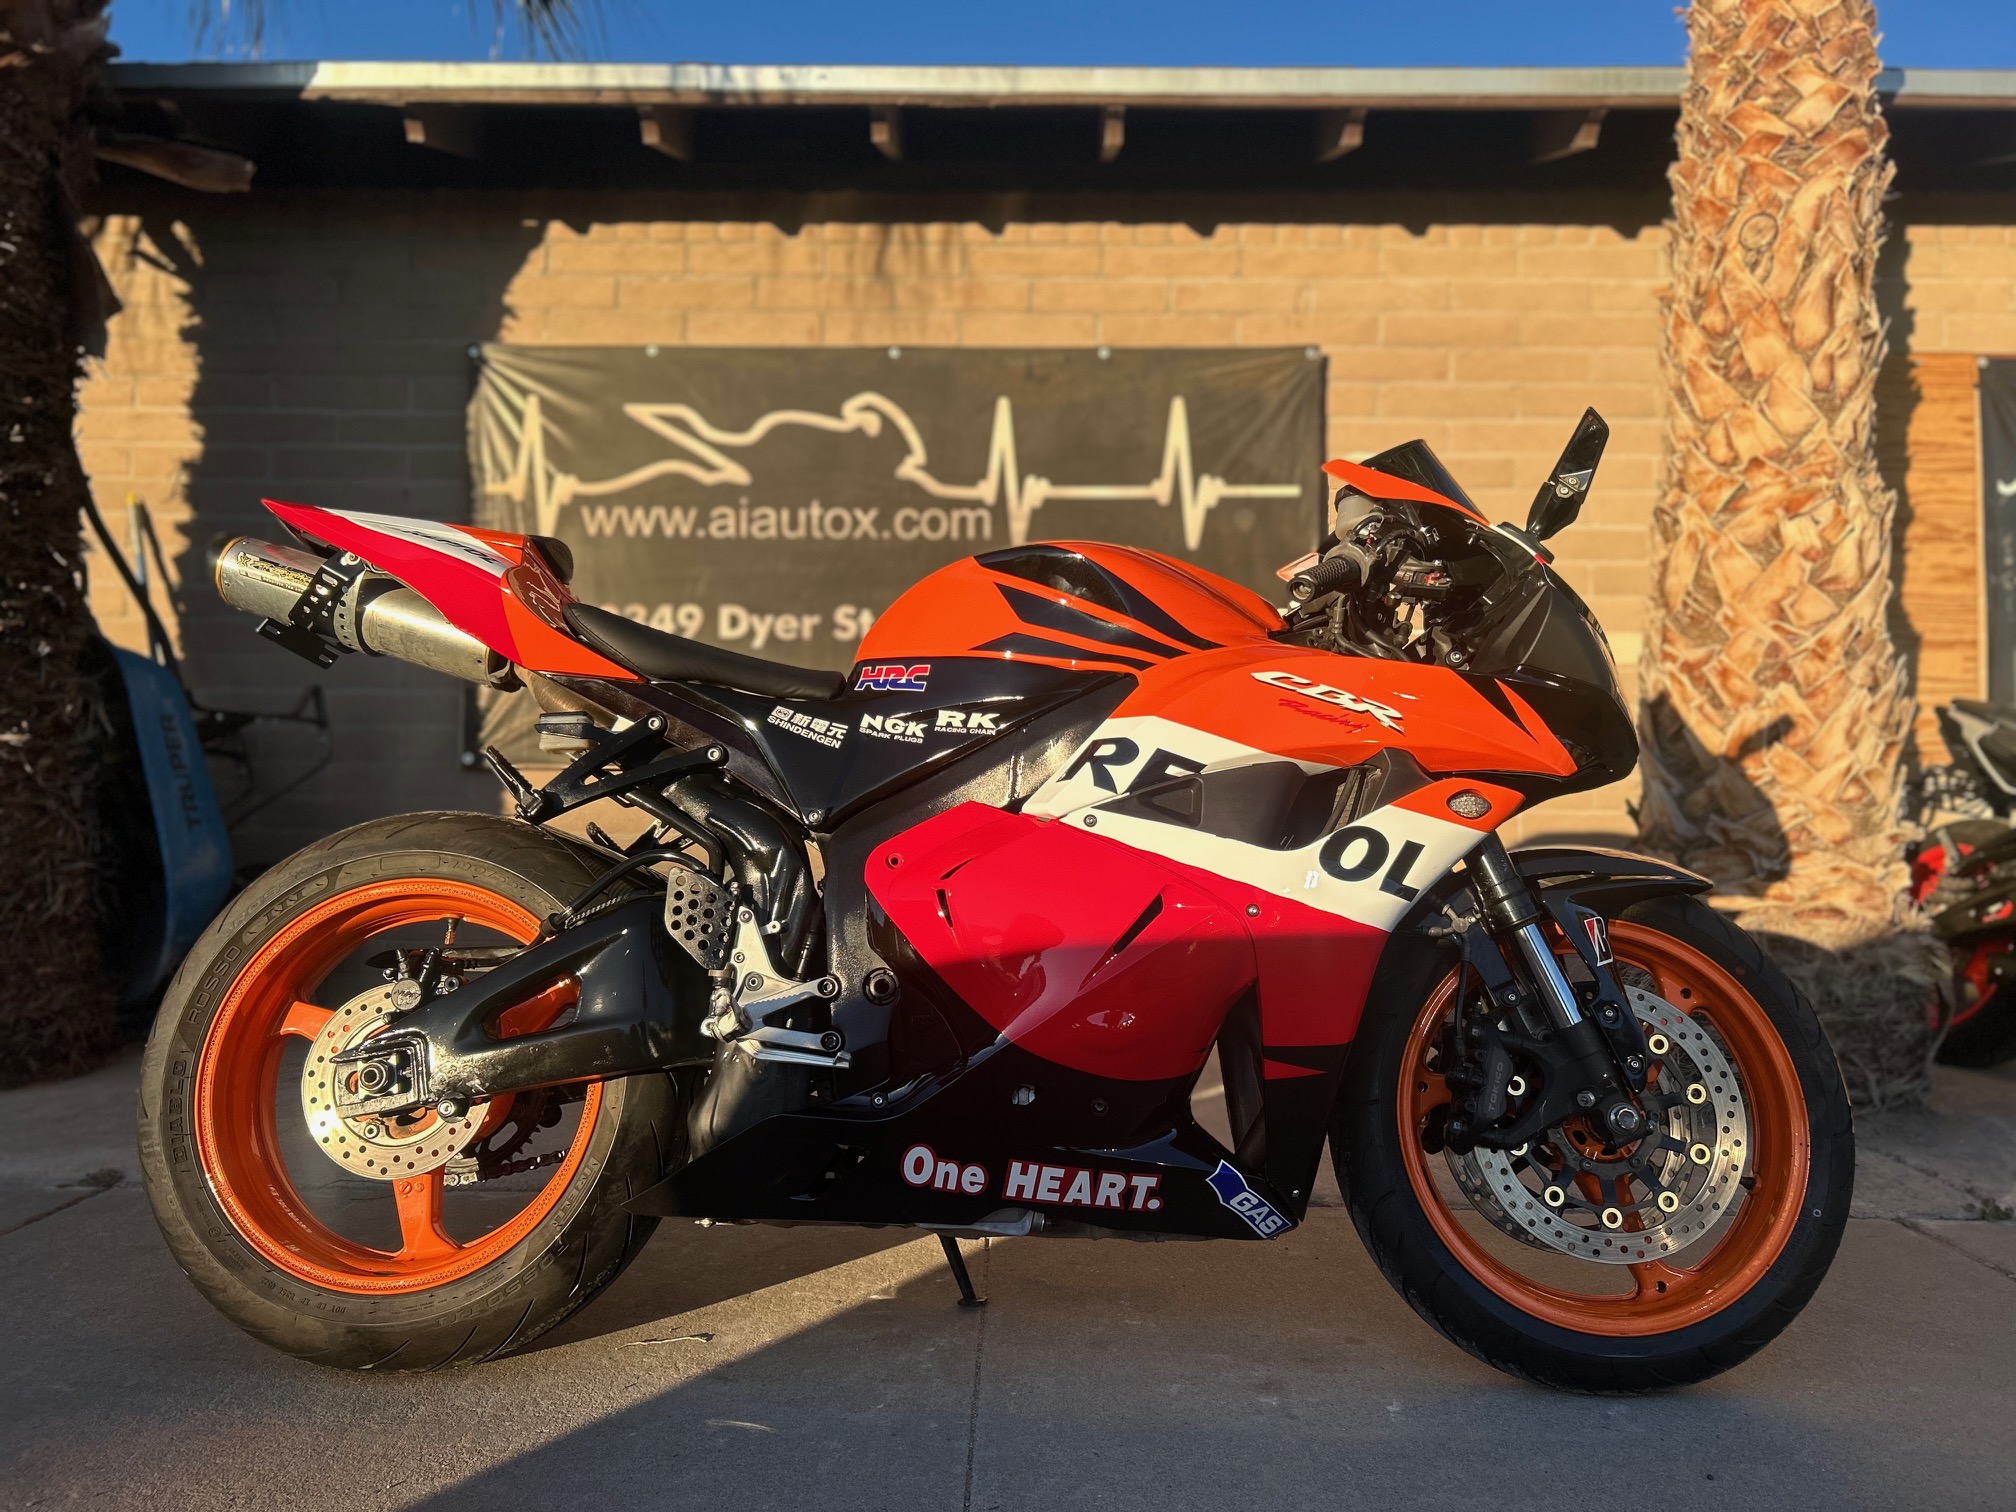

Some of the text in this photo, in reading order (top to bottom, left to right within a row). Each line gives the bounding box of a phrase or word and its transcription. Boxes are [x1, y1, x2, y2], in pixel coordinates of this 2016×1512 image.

[581, 498, 993, 541] www.aiautox.com
[718, 604, 822, 650] Dyer
[854, 664, 931, 692] HRC
[935, 709, 1000, 729] RK
[1250, 671, 1407, 738] CBR
[1278, 698, 1370, 734] Racing
[767, 715, 842, 749] SHINDENGEN
[859, 727, 924, 744] SPARK PLUGS
[860, 713, 928, 738] NGK
[934, 726, 997, 736] RACING CHAIN
[168, 1060, 188, 1164] DIABLO
[186, 945, 243, 1025] ROSSO
[1488, 1061, 1504, 1112] TOKICO
[902, 1143, 1164, 1212] One HEART.
[1229, 1191, 1283, 1234] GAS
